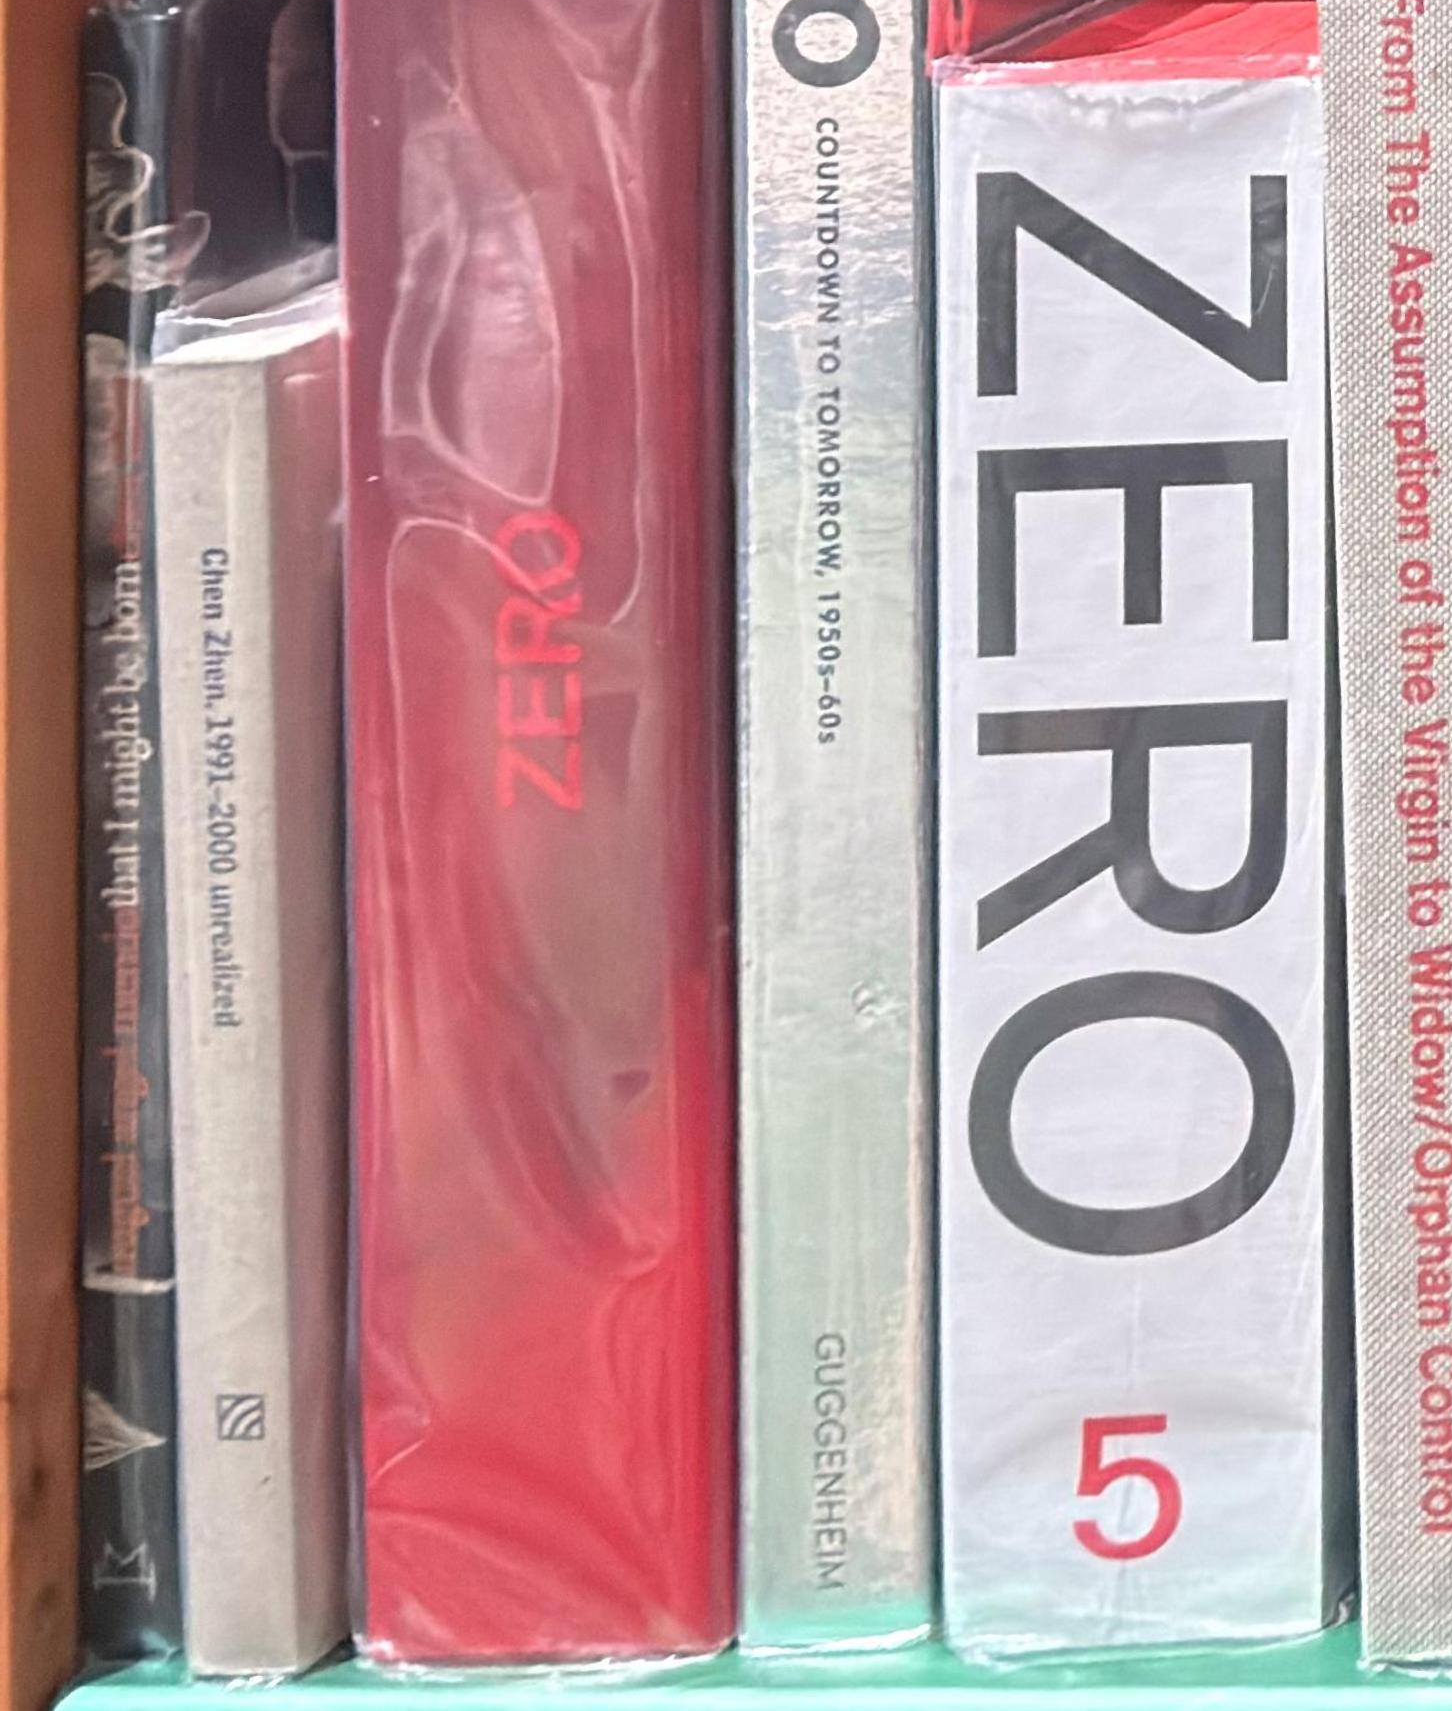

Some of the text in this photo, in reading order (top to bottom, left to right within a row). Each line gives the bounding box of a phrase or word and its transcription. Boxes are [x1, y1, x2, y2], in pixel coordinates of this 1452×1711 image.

[816, 117, 839, 324] COUNTDOWN
[1385, 131, 1431, 226] The
[817, 335, 839, 376] TO
[1386, 242, 1441, 542] Assumption
[815, 388, 842, 577] TOMORROW,
[102, 561, 140, 643] born
[202, 548, 229, 621] Chen
[1399, 559, 1445, 606] of
[102, 653, 139, 694] be
[495, 512, 583, 811] ZERO
[1401, 624, 1446, 705] the
[99, 703, 153, 808] might
[965, 172, 1296, 1258] ZERO
[1395, 718, 1450, 864] Virgin
[100, 844, 139, 908] that
[1408, 882, 1450, 927] to
[209, 887, 241, 1029] unrealized
[814, 1332, 847, 1591] GUGGENHEIM
[1075, 1413, 1184, 1558] 5
